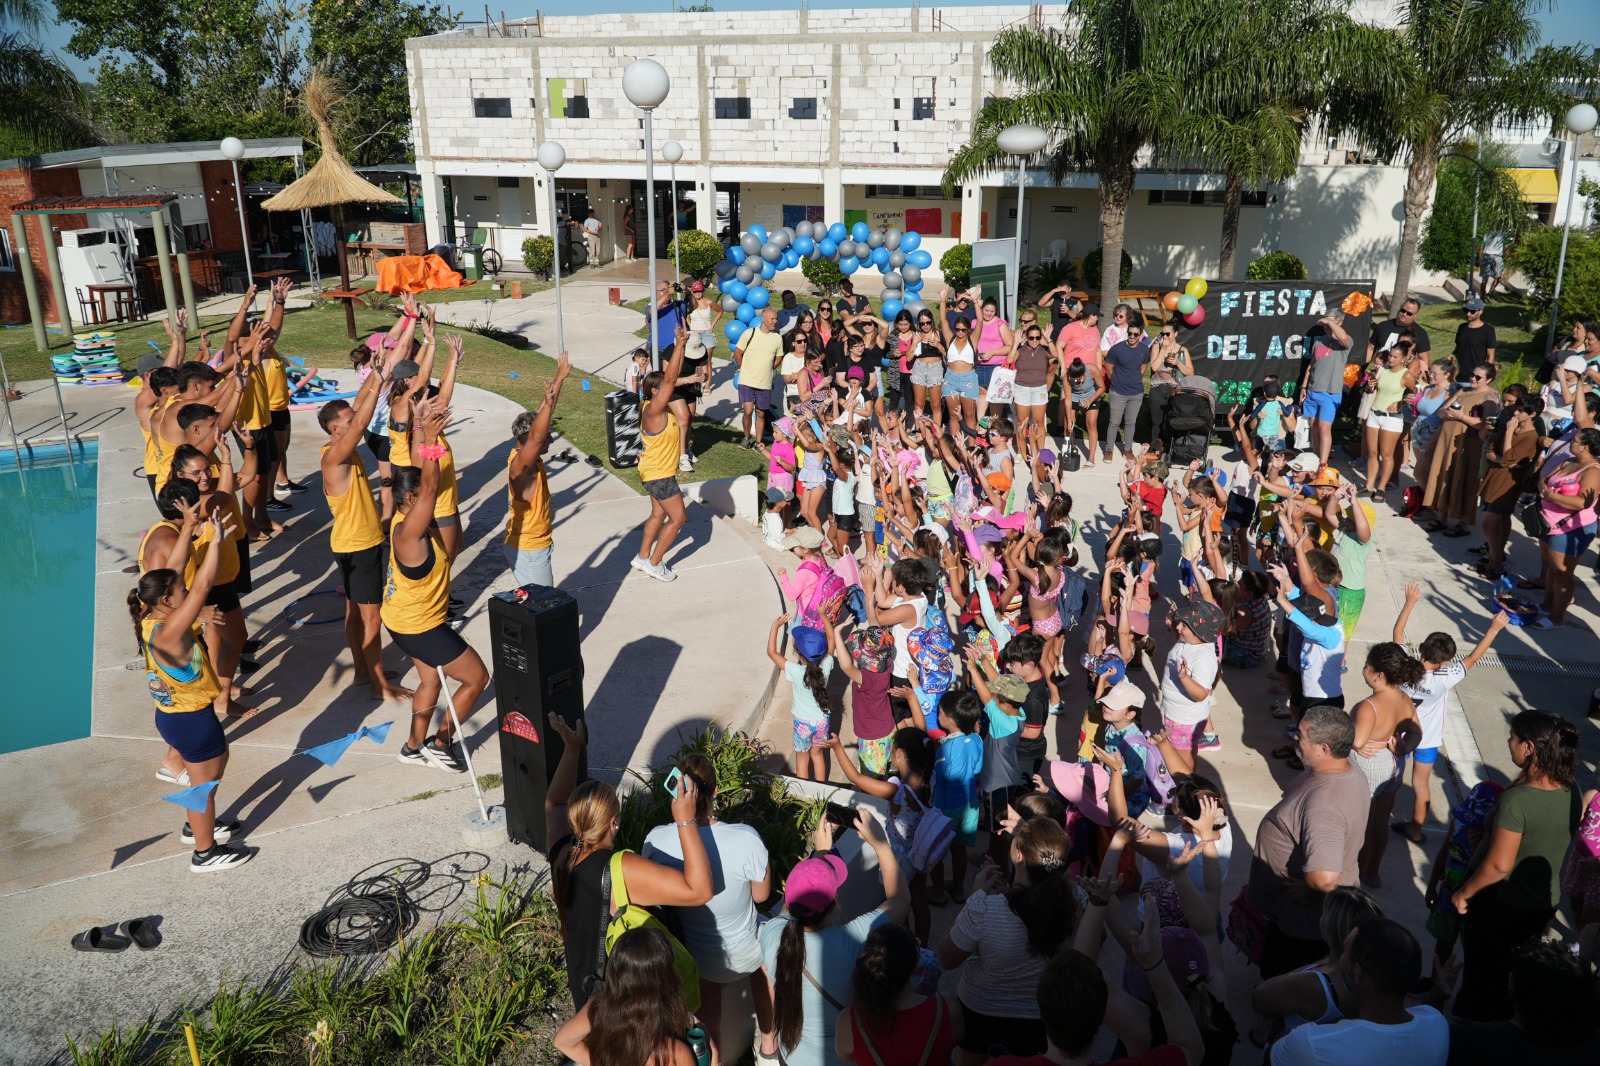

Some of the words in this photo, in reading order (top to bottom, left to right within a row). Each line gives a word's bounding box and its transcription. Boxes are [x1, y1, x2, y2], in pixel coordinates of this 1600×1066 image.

[1220, 288, 1327, 318] FIESTA
[1207, 334, 1256, 360] DEL
[1265, 334, 1319, 359] AGU
